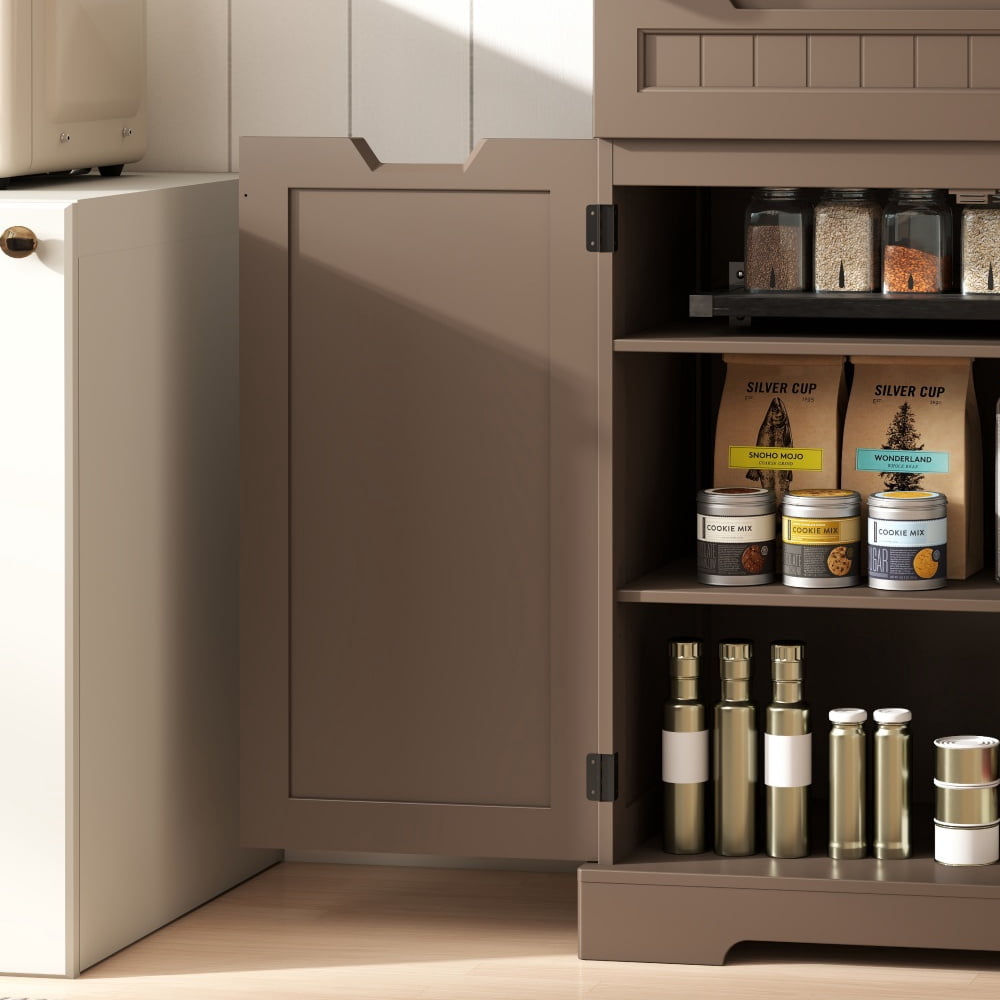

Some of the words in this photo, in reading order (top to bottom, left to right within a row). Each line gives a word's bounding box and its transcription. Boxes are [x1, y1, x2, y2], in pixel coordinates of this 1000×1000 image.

[746, 381, 788, 394] SILVER
[791, 382, 817, 394] CUP
[874, 384, 916, 397] SILVER
[919, 385, 946, 398] CUP
[748, 451, 779, 459] SNOHO
[874, 454, 933, 463] WONDERLAND
[706, 524, 736, 532] COOKIE
[792, 526, 821, 534] COOKIE
[878, 528, 908, 536] COOKIE
